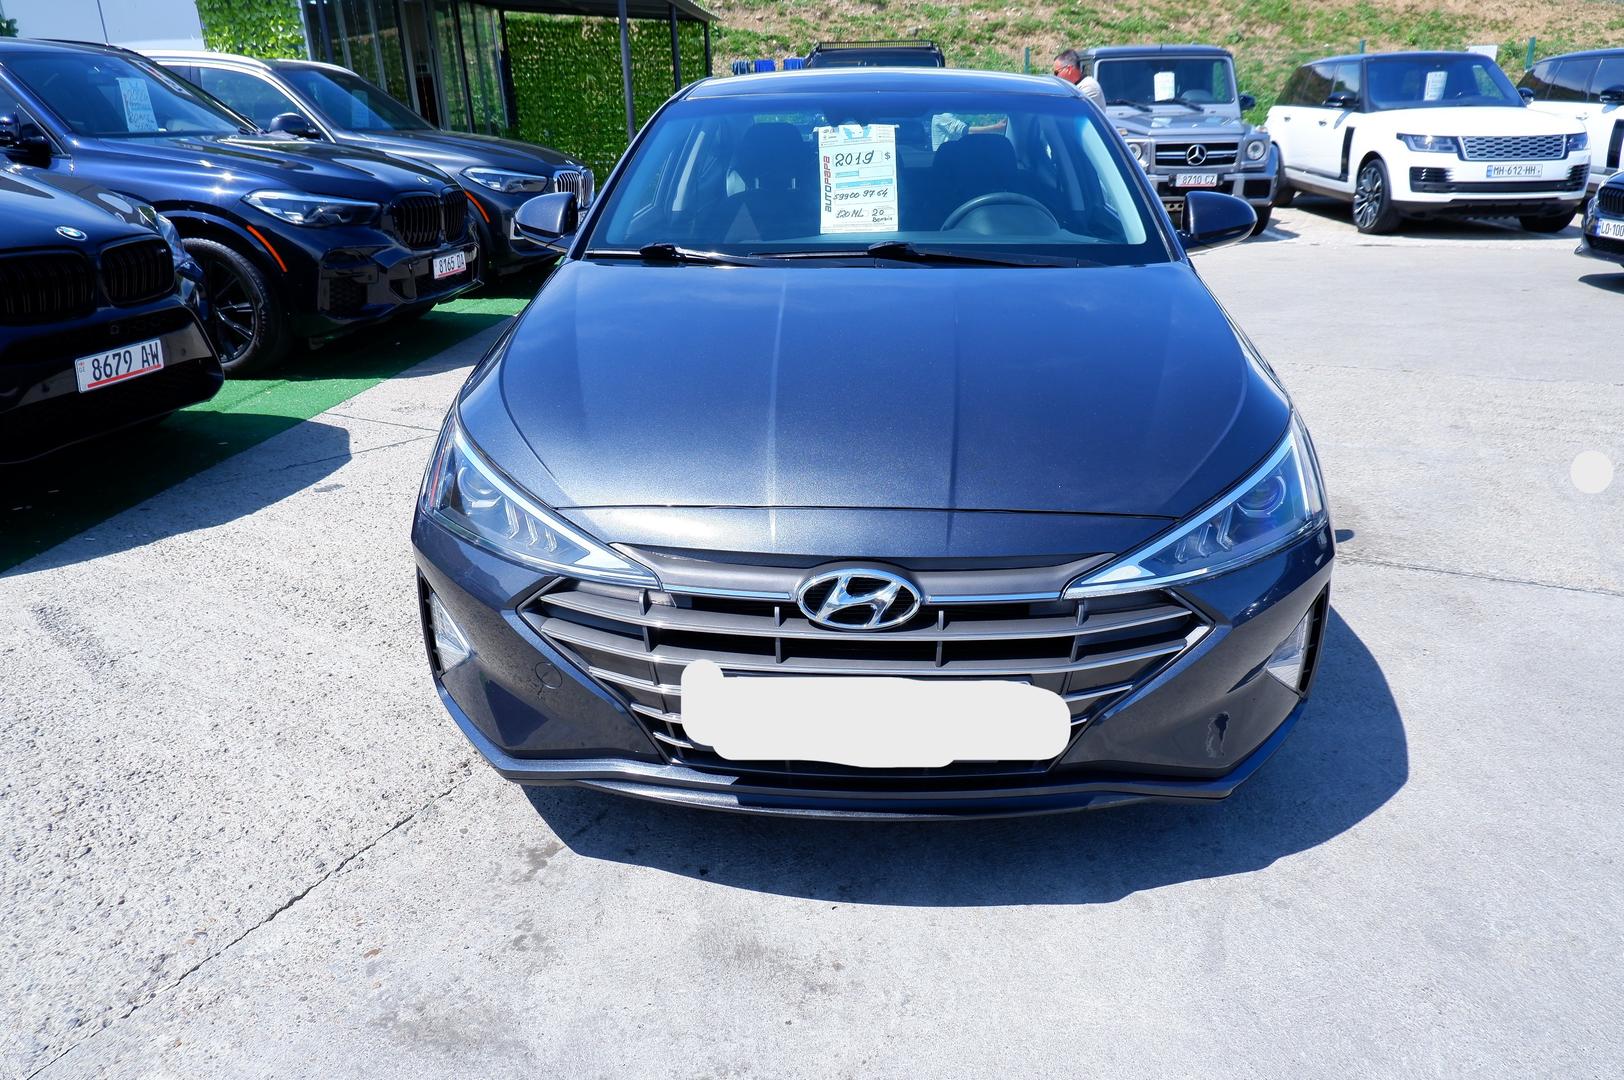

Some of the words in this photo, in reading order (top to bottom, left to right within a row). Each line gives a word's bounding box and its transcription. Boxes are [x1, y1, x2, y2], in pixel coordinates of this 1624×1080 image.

[835, 150, 875, 167] 2019
[884, 152, 891, 160] $
[1182, 175, 1202, 185] 8710
[438, 256, 455, 274] 8165
[91, 350, 133, 382] 8679
[141, 342, 160, 369] AW
